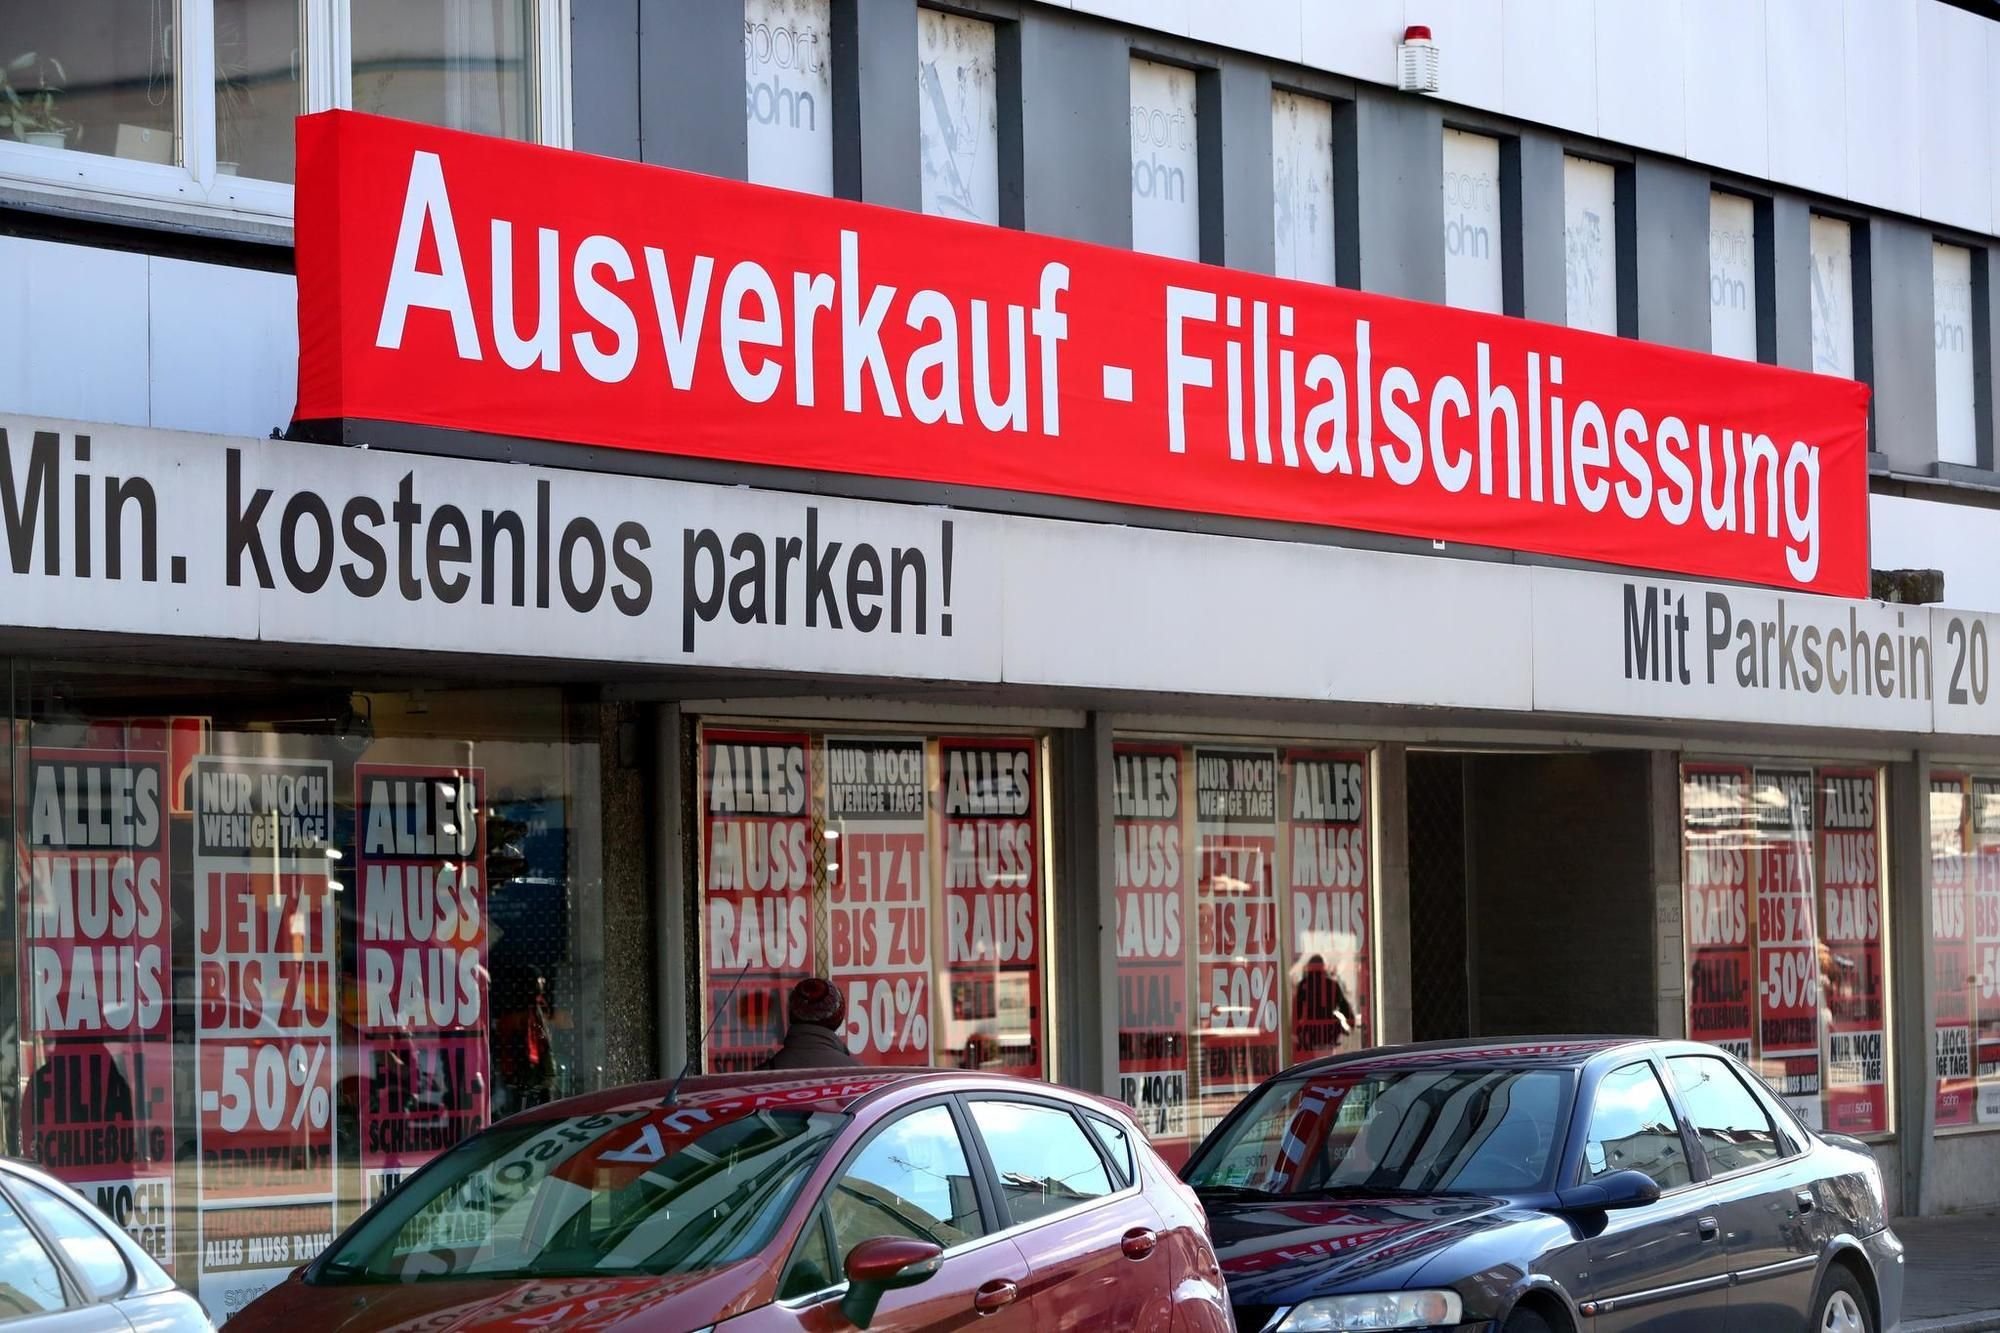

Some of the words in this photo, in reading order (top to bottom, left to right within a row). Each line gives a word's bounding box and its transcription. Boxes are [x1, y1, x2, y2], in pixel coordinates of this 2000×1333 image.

[1131, 106, 1186, 153] port
[1132, 151, 1185, 204] ohn
[1446, 213, 1488, 260] ohn
[1711, 267, 1746, 311] ohn
[1935, 313, 1964, 352] ohn
[376, 150, 1070, 436] Ausverkauf
[1165, 285, 1820, 583] Filialschliessung
[0, 428, 187, 584] Min.
[225, 448, 653, 617] kostenlos
[683, 506, 954, 653] parken!
[1623, 583, 1691, 685] Mit
[1705, 591, 1932, 702] Parkschein
[1947, 617, 1989, 706] 20
[709, 744, 806, 814] ALLES
[830, 748, 867, 785] NUR
[873, 749, 922, 786] NOCH
[945, 751, 1030, 815] ALLES
[1198, 757, 1229, 791] NUR
[1232, 758, 1273, 792] NOCH
[1292, 760, 1362, 822] ALLES
[33, 767, 160, 848] ALLES
[201, 773, 252, 814] NUR
[261, 773, 325, 818] NOCH
[364, 779, 478, 857] ALLES
[831, 784, 884, 812] WENIGE
[888, 785, 922, 813] TAGE
[1246, 790, 1274, 817] TAGE
[1824, 777, 1874, 828] ALLES
[202, 814, 274, 849] WENIGE
[278, 815, 326, 849] TAGE
[708, 821, 807, 891] MUSS
[944, 822, 1032, 889] MUSS
[1292, 826, 1363, 888] MUSS
[1824, 833, 1876, 885] MUSS
[829, 832, 925, 904] JETZT
[1688, 834, 1745, 886] MUSS
[34, 859, 162, 940] MUSS
[200, 872, 330, 954] JETZT
[363, 864, 481, 943] MUSS
[1690, 889, 1747, 945] RAUS
[1759, 896, 1785, 942] BIS
[1825, 887, 1879, 941] RAUS
[1932, 887, 1965, 939] AUS
[709, 896, 808, 970] RAUS
[831, 908, 878, 968] BIS
[887, 906, 926, 967] ZU
[945, 894, 1034, 963] RAUS
[1198, 901, 1236, 956] BIS
[1244, 901, 1277, 956] ZU
[37, 945, 163, 1031] RAUS
[200, 960, 260, 1030] BIS
[278, 959, 329, 1029] ZU
[366, 948, 482, 1028] RAUS
[1200, 965, 1278, 1033] -50%
[1760, 950, 1816, 1010] -50%
[1831, 1036, 1852, 1062] NUR
[1854, 1033, 1881, 1060] NOCH
[1862, 1060, 1881, 1081] TAGE
[1949, 1055, 1969, 1077] TAGE
[201, 1040, 329, 1133] -50%
[1142, 1073, 1184, 1107] NOCH
[97, 1183, 165, 1228] NOCH
[205, 1238, 244, 1267] ALLES
[248, 1235, 290, 1264] MUSS
[224, 1284, 268, 1313] spor
